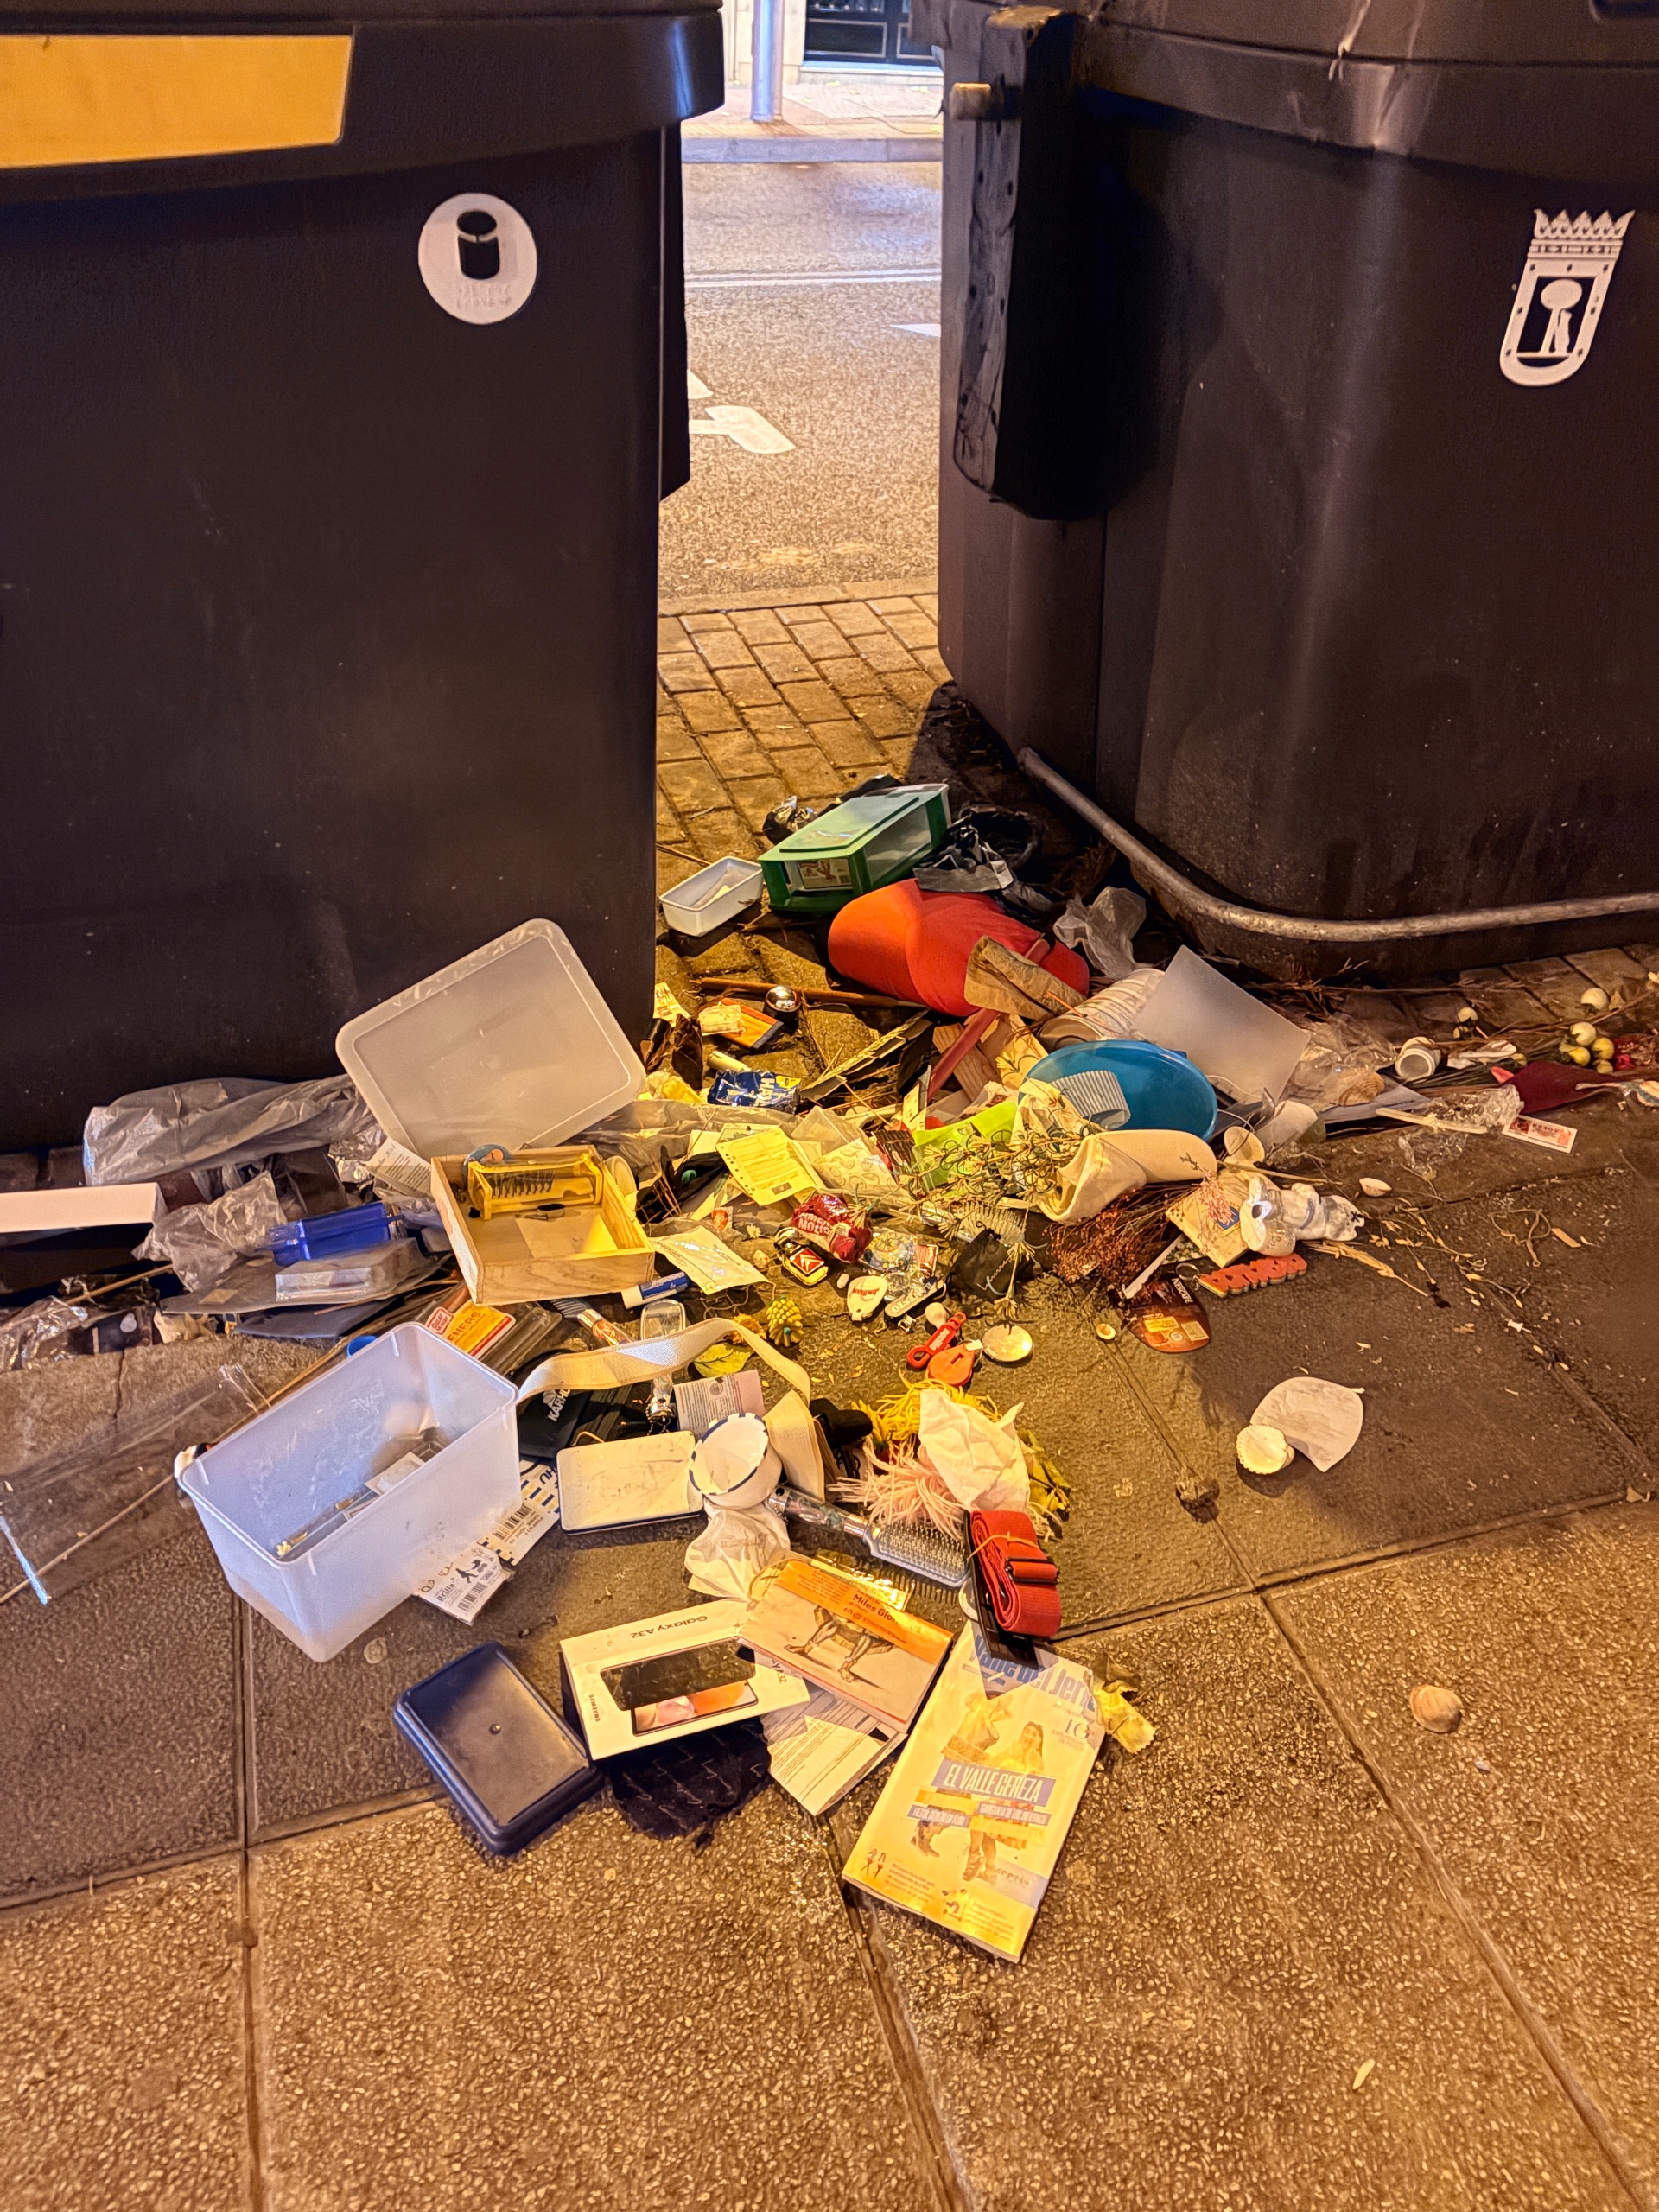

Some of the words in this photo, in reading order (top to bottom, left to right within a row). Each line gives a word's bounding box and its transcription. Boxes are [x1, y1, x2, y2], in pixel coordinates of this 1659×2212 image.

[446, 1309, 481, 1343] ENERS
[852, 1592, 877, 1612] Miles
[630, 1627, 654, 1640] A32
[657, 1615, 709, 1632] Galaxy
[588, 1694, 601, 1723] SAMSUNG
[943, 1764, 959, 1788] EL
[959, 1766, 996, 1796] VALLE
[995, 1773, 1044, 1803] CEREZA
